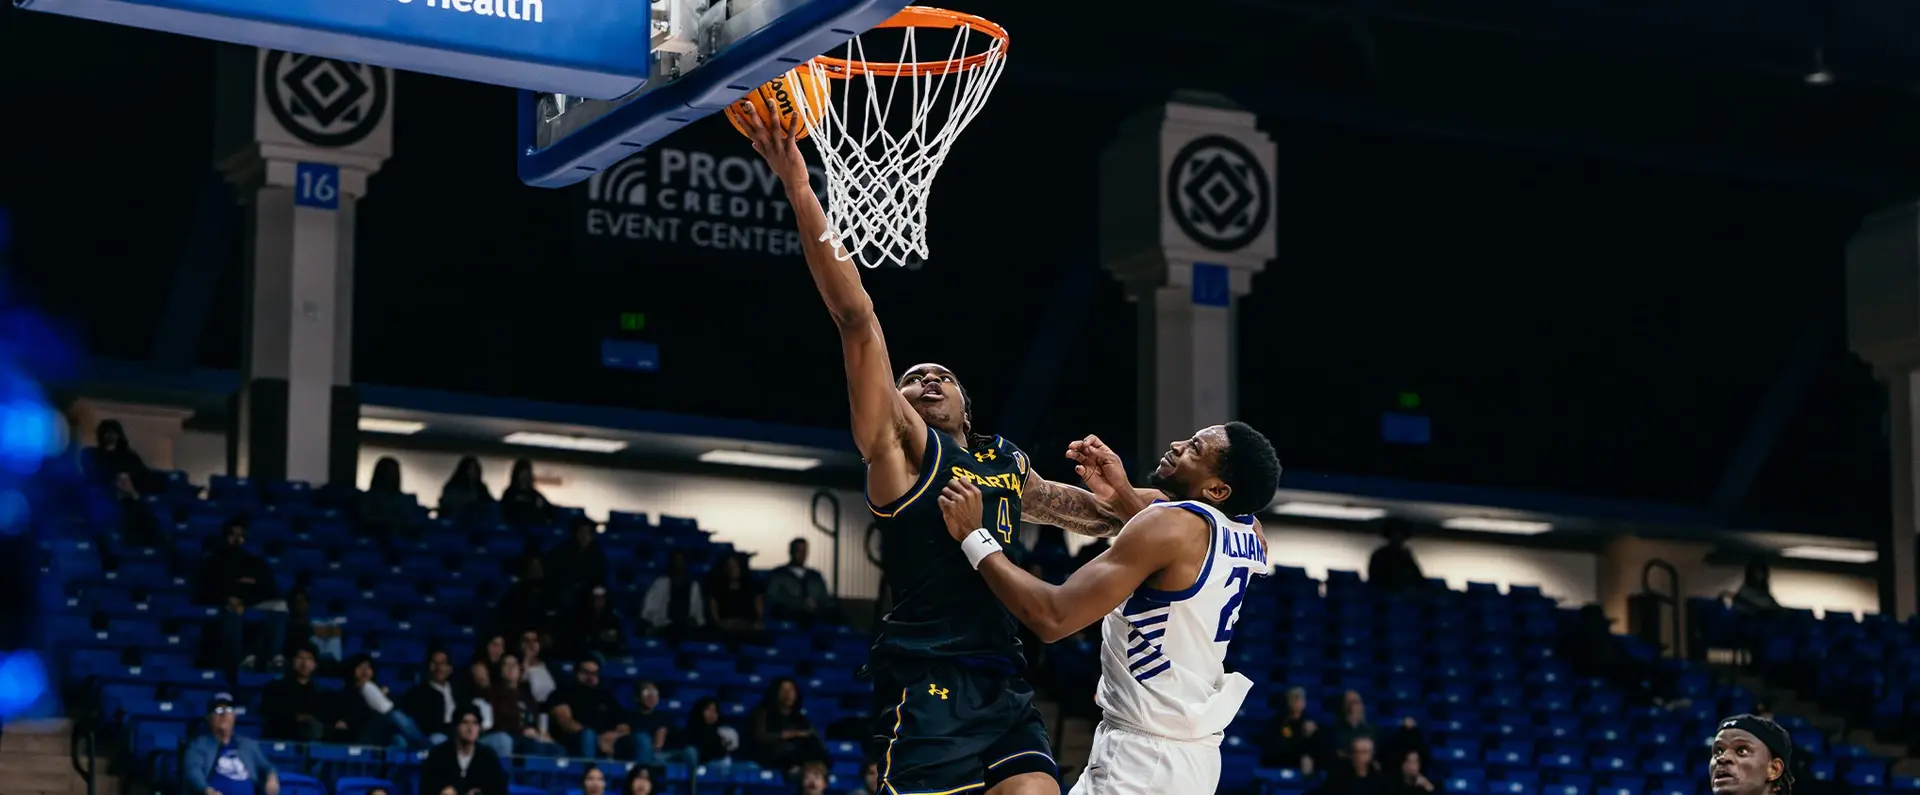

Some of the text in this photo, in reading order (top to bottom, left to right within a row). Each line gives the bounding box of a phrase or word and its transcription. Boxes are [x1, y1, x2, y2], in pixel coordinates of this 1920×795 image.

[301, 172, 335, 201] 16
[656, 187, 790, 222] CREDIT
[586, 208, 682, 242] EVENT
[690, 218, 803, 257] CENTER
[951, 465, 1022, 499] SPARTA
[997, 496, 1012, 544] 4
[1213, 566, 1250, 643] 2
